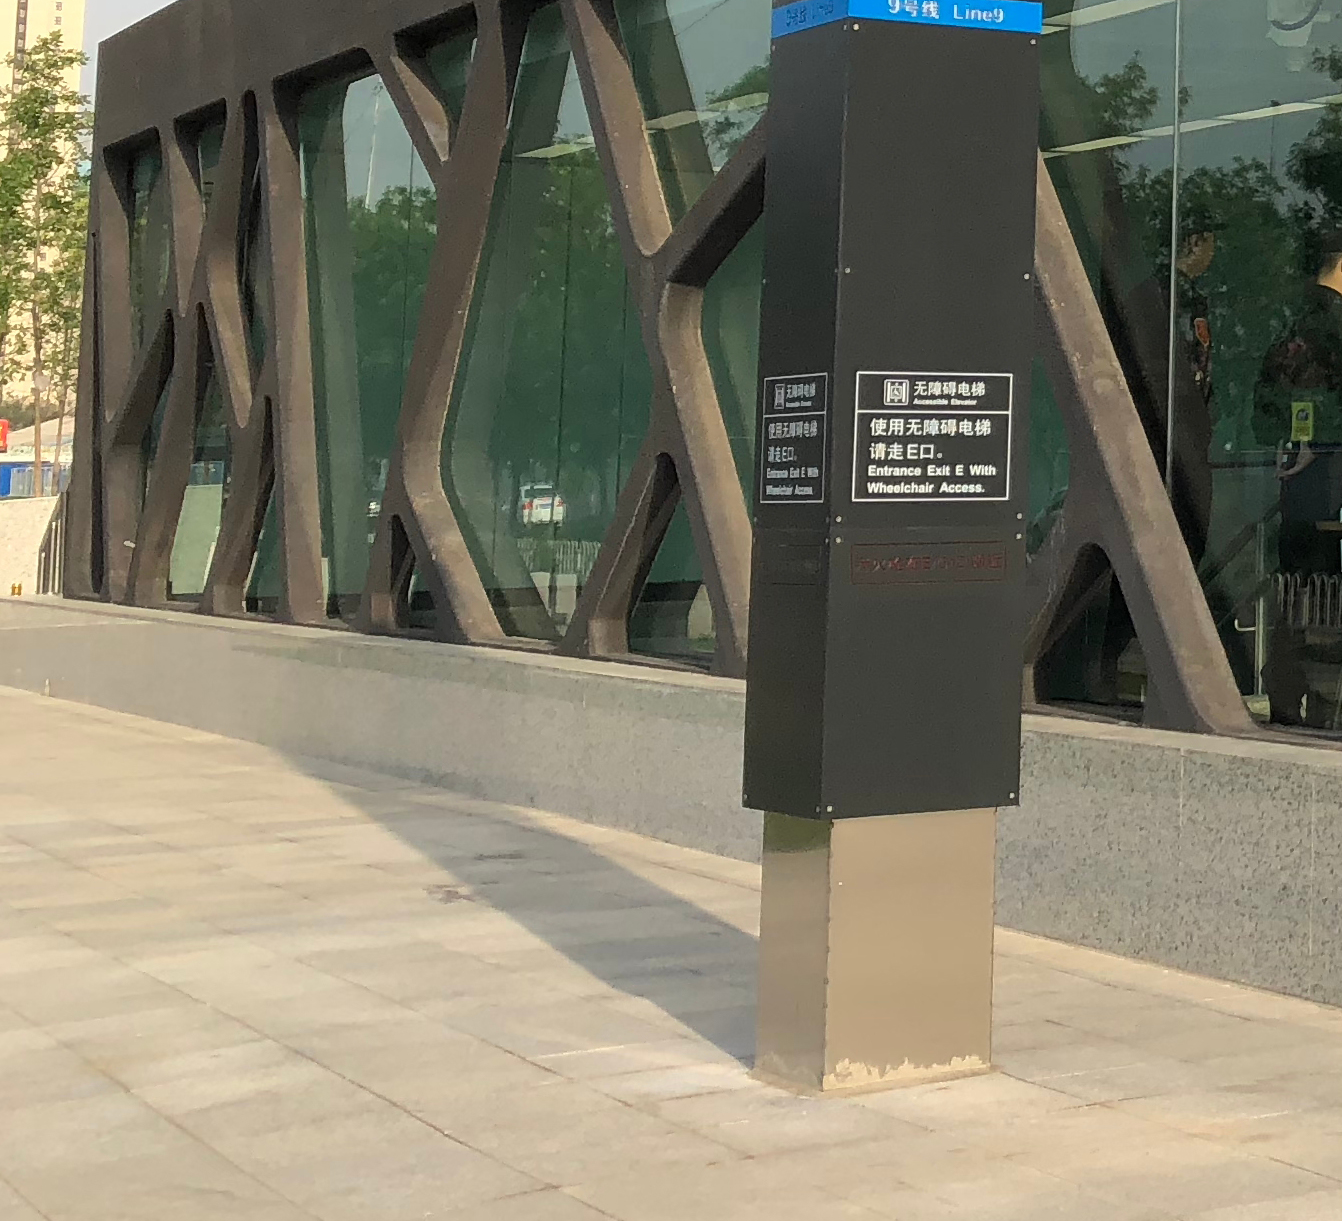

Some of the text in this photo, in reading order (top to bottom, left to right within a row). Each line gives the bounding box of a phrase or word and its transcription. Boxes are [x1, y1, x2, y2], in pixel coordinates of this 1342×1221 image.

[953, 4, 1004, 23] Line9
[913, 381, 986, 397] 无障碍电梯
[870, 417, 991, 436] 使用无障碍电梯
[867, 464, 996, 476] Entrance Exit E With
[867, 481, 934, 494] Wheelchair
